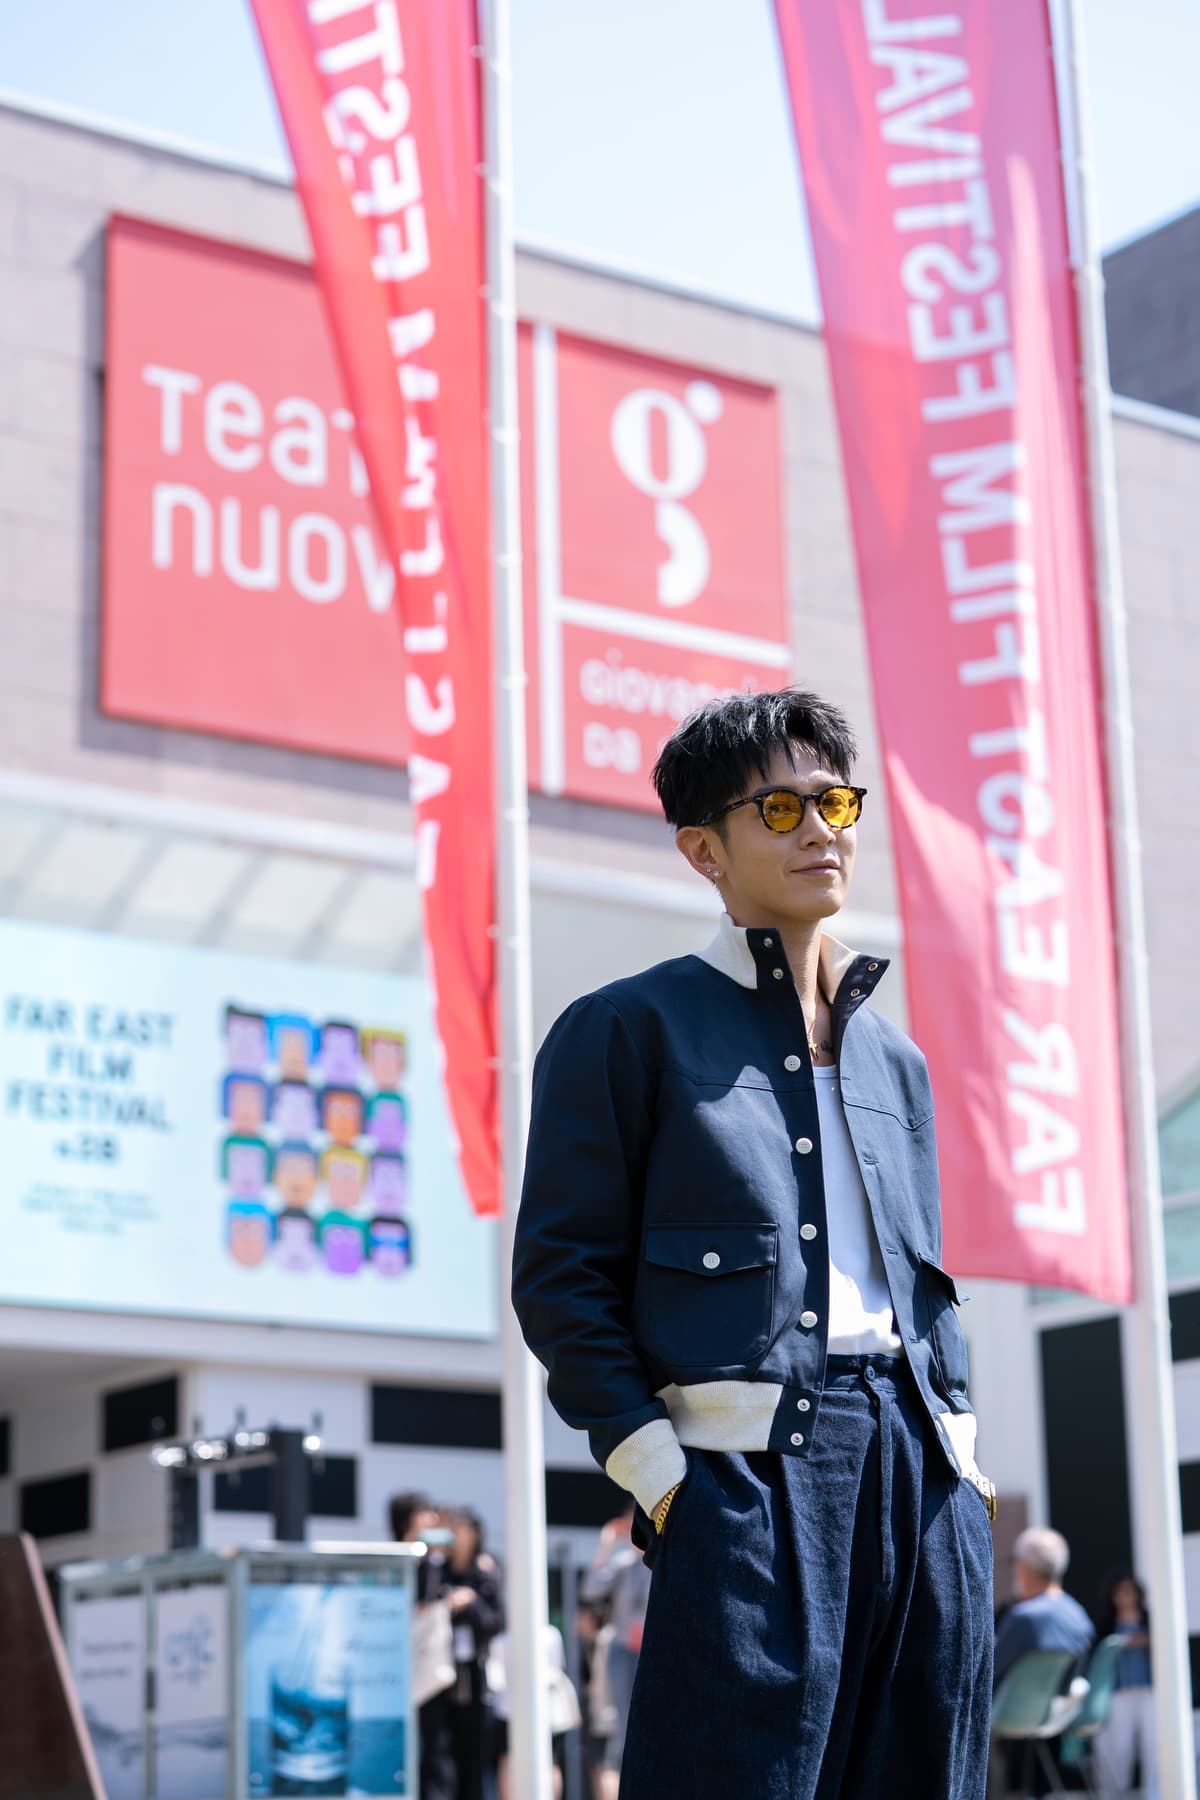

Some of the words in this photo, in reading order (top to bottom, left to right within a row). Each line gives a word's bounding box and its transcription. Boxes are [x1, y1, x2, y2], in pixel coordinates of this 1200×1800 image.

[4, 994, 74, 1033] FAR
[84, 1003, 176, 1048] EAST
[47, 1042, 135, 1083] FILM
